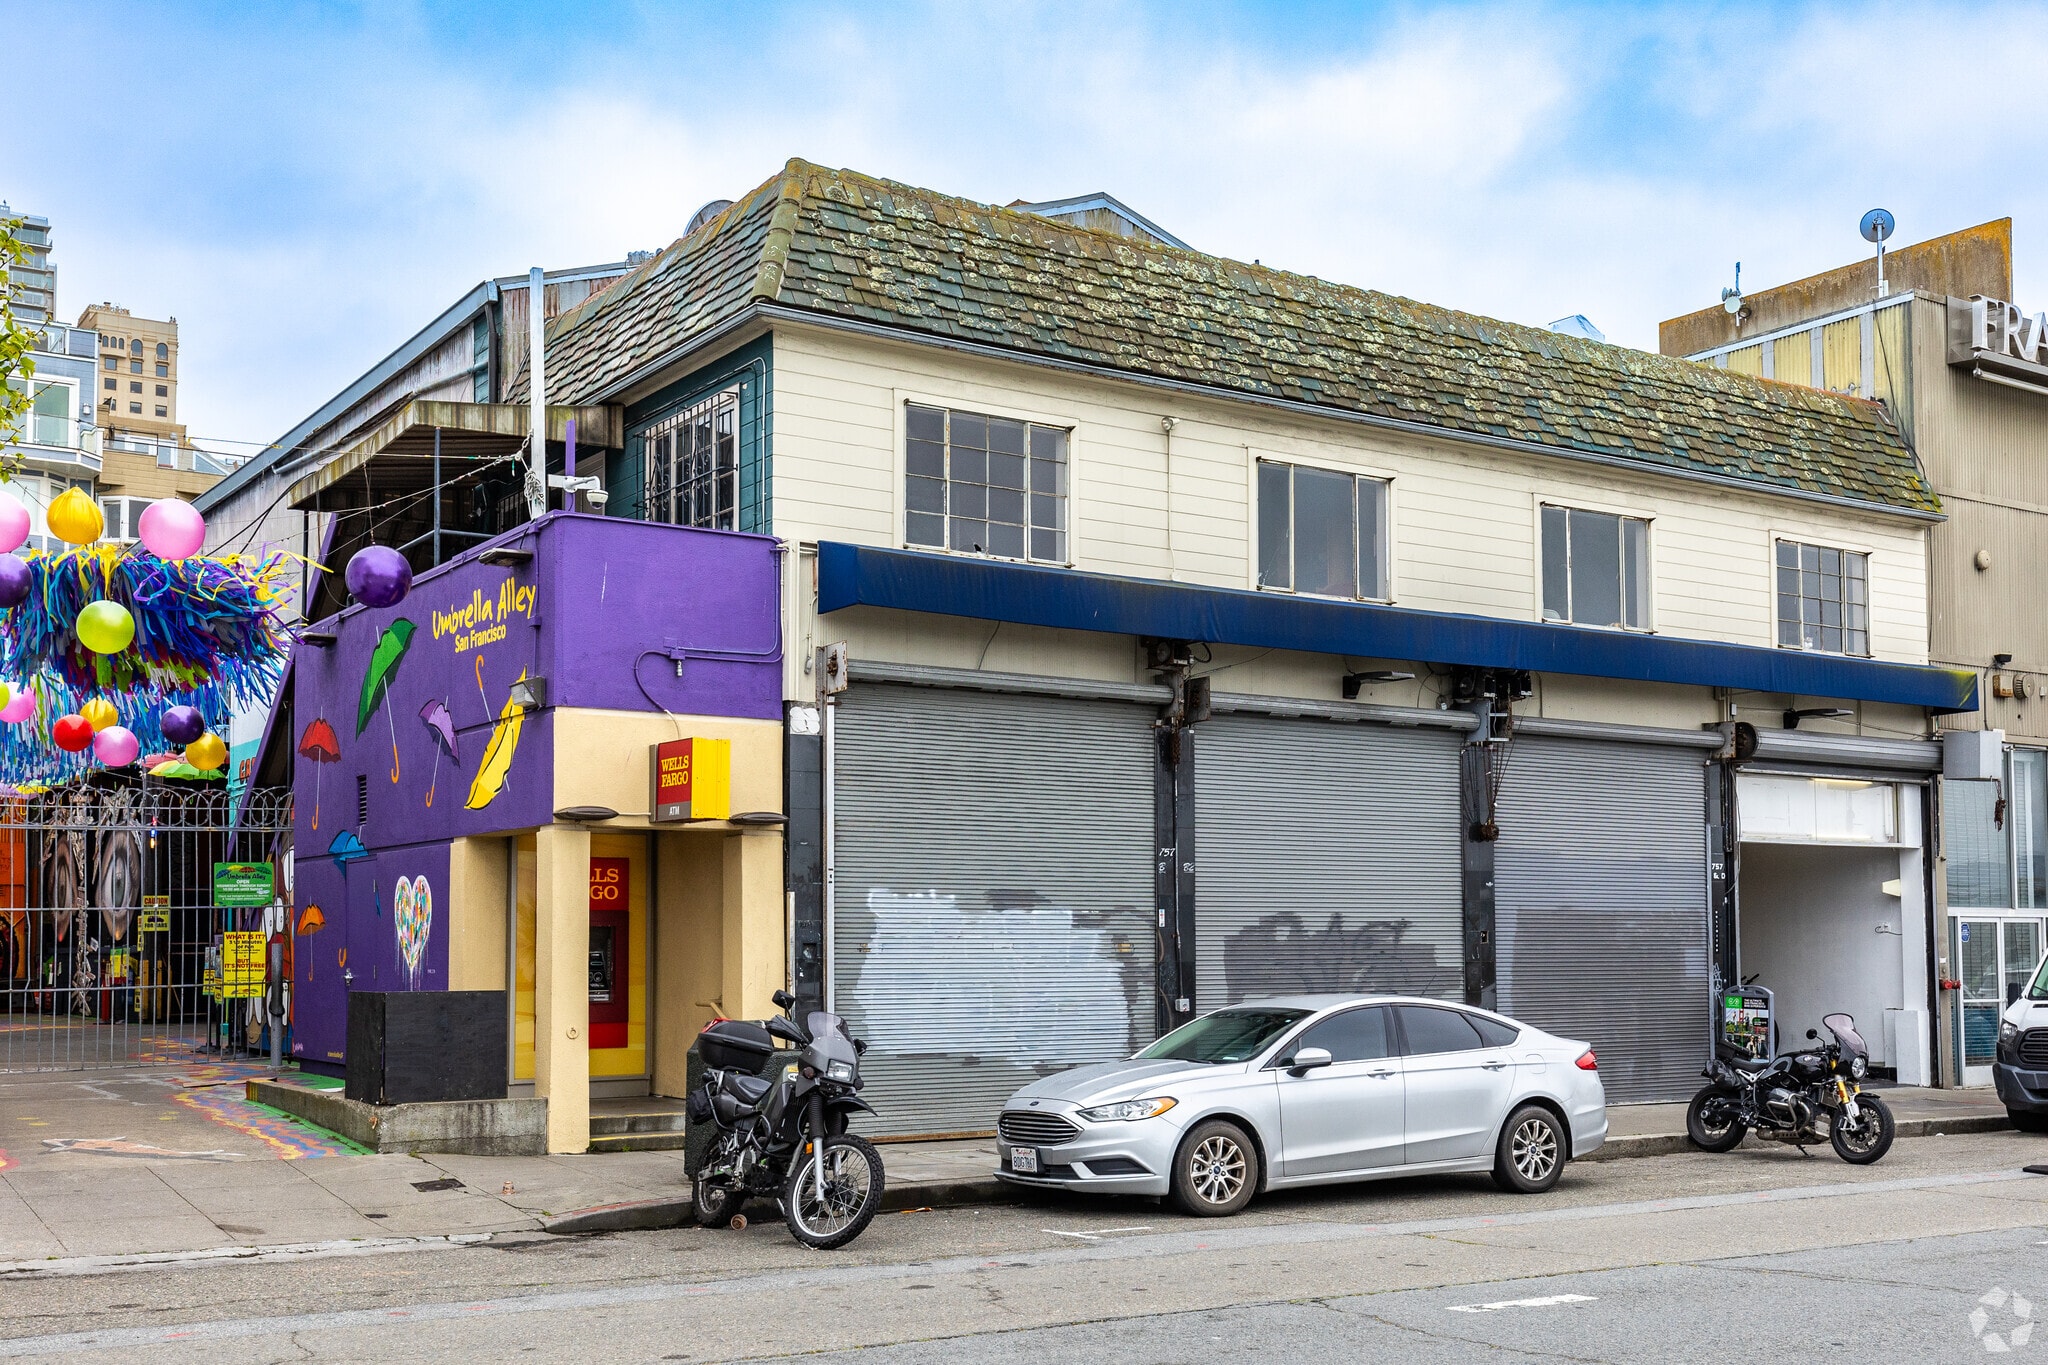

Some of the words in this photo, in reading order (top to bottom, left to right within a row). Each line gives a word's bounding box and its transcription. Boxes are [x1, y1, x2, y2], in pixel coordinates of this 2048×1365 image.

[433, 589, 493, 640] Umbrella
[497, 577, 536, 622] Alley
[455, 635, 469, 653] San
[470, 624, 506, 648] Francisco
[661, 755, 689, 772] WELLS
[661, 771, 689, 788] FARGO
[669, 806, 680, 816] ATM
[1159, 847, 1175, 857] 757
